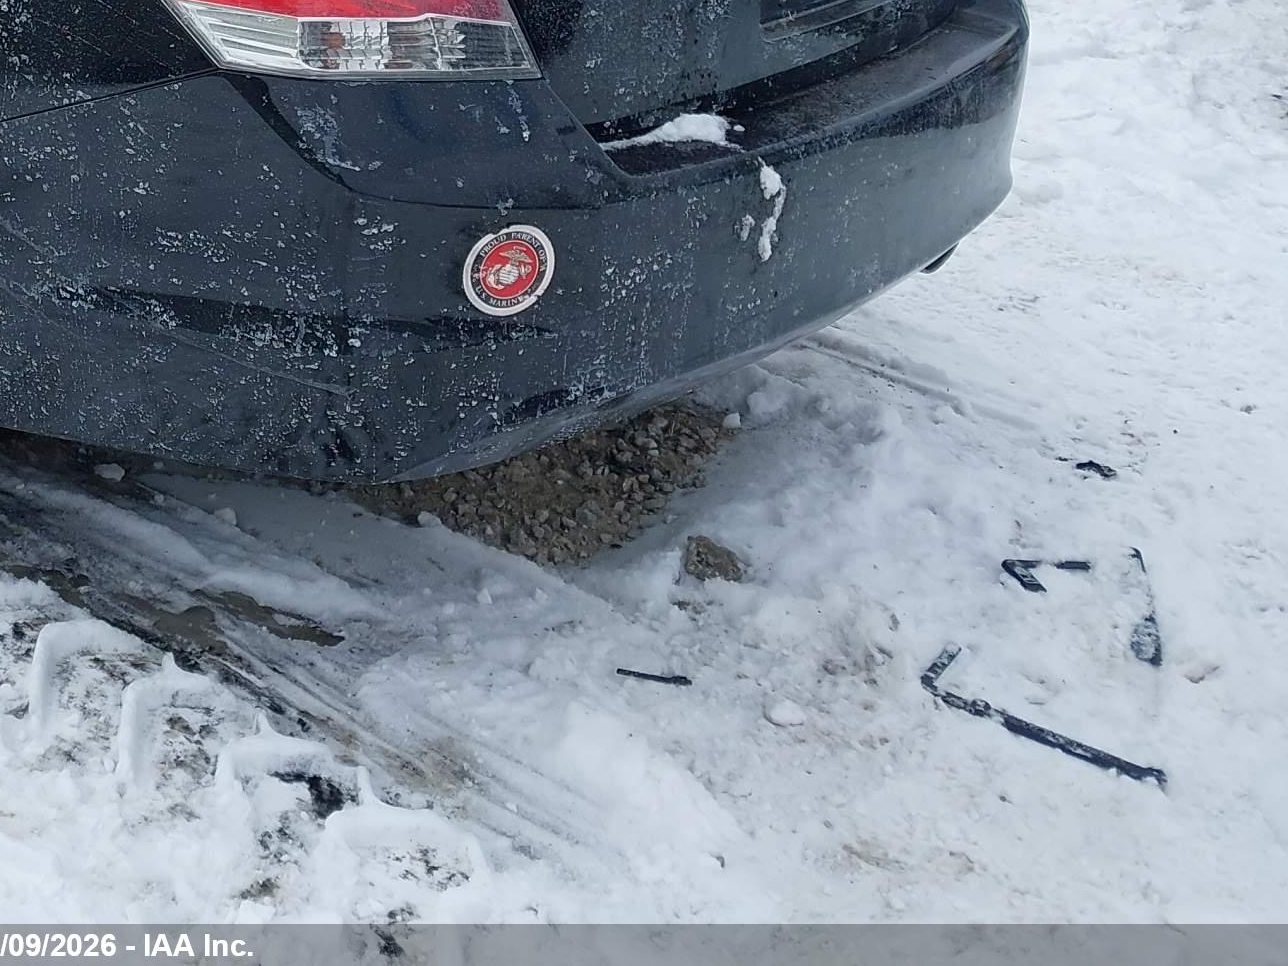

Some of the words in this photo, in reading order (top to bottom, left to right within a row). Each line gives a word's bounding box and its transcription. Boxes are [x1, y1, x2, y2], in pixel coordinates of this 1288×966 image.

[480, 234, 507, 257] PROUD
[512, 232, 541, 248] PARENT
[488, 294, 525, 307] MARINE
